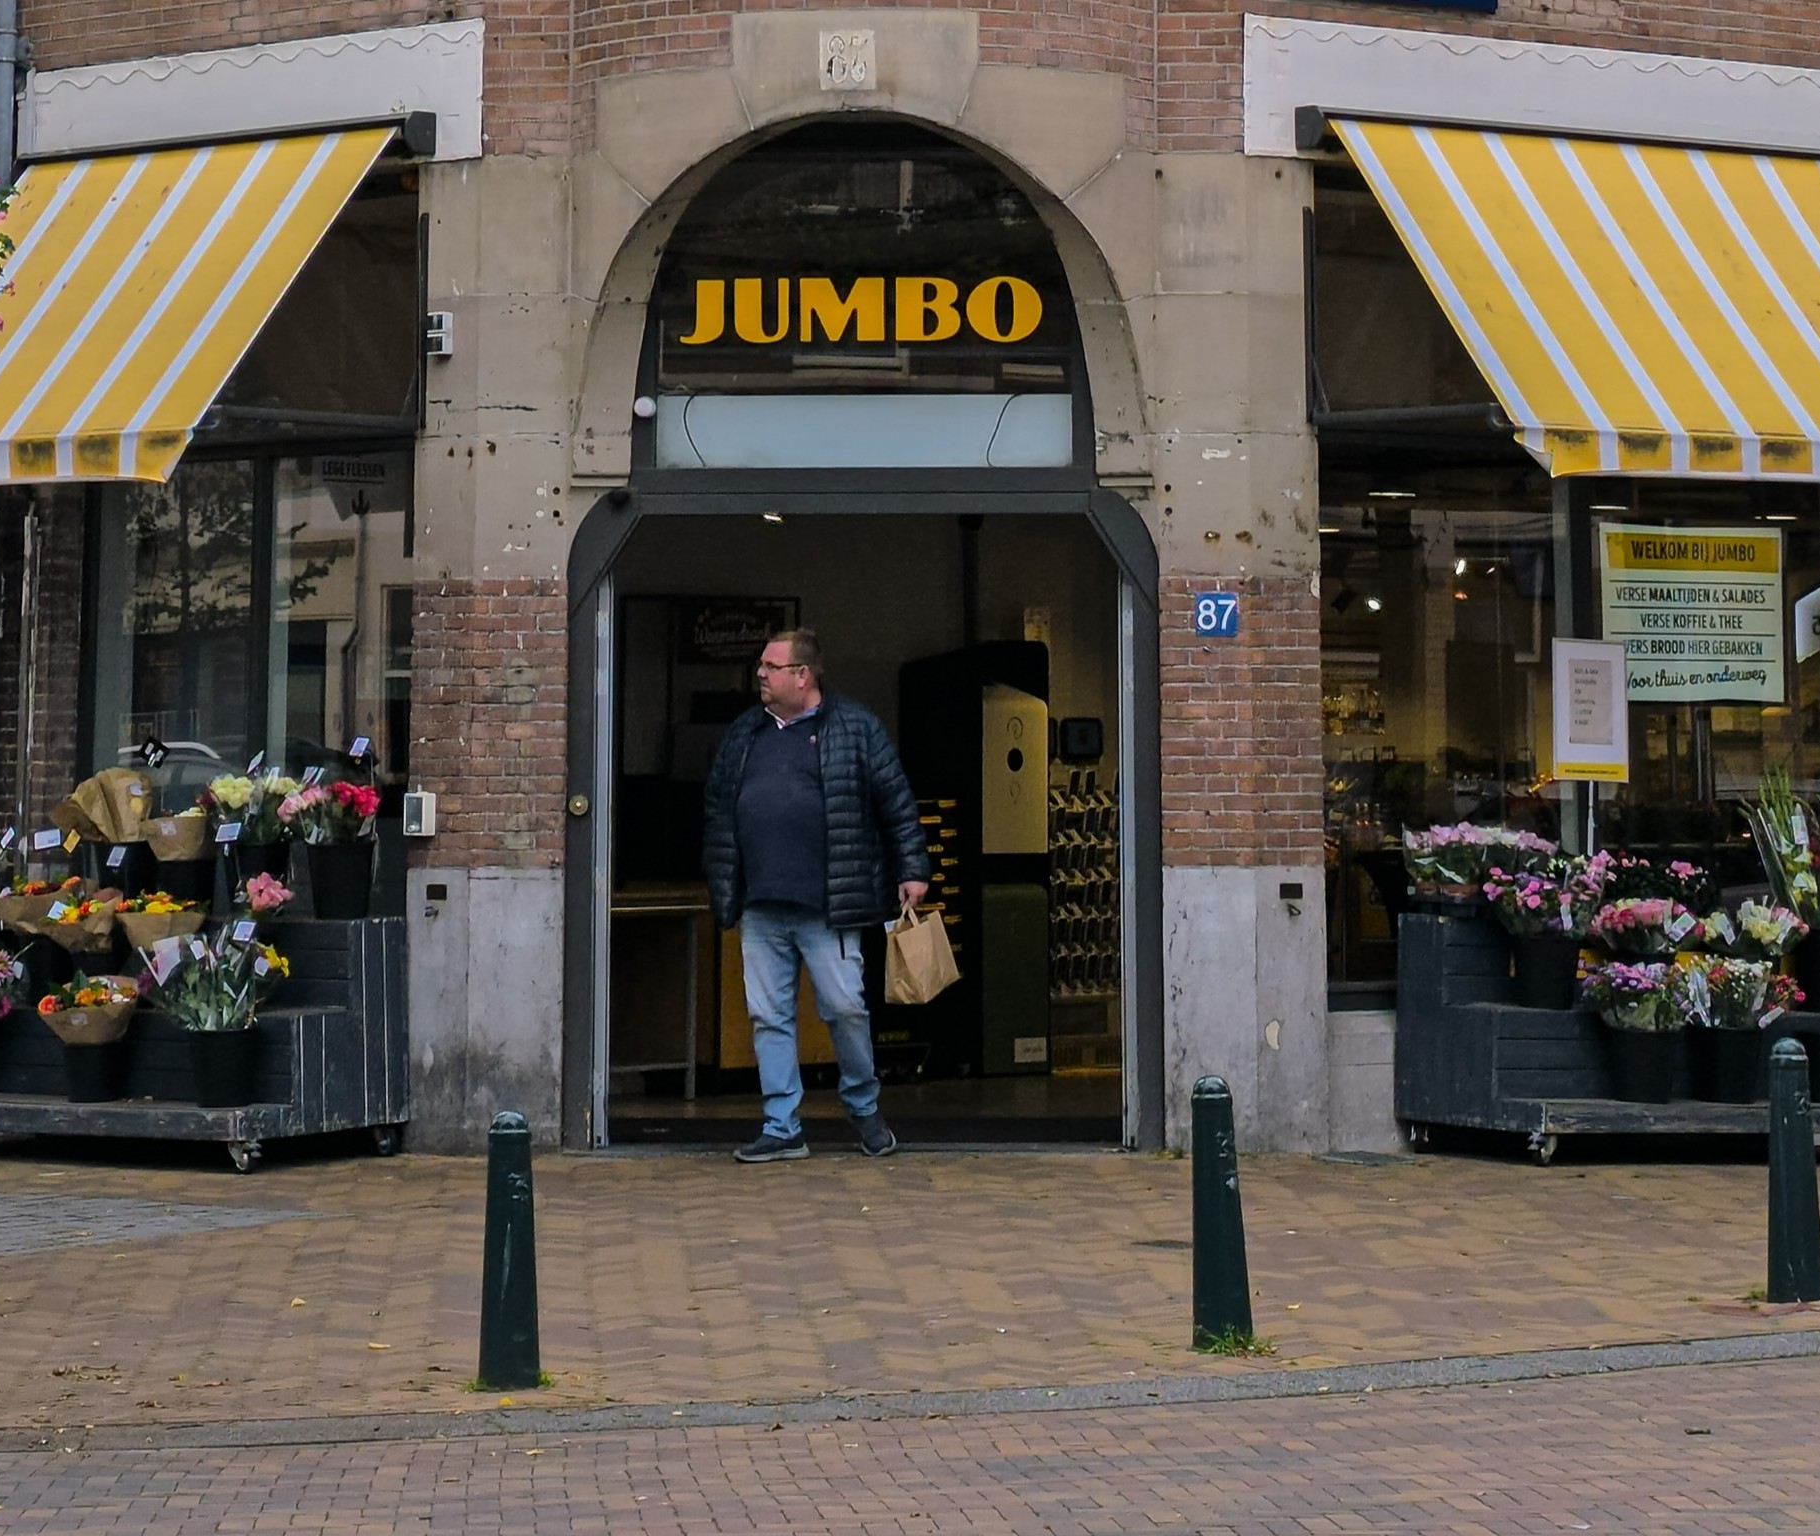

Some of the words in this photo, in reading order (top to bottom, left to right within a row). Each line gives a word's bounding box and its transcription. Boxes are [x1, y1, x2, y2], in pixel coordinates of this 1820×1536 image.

[679, 275, 1043, 345] JUMBO
[1631, 540, 1689, 560] WELKOM
[1692, 542, 1709, 563] BIJ
[1713, 543, 1756, 563] JUMBO
[1616, 586, 1647, 602] VERSE
[1649, 587, 1711, 604] MAALTIJDEN
[1712, 589, 1720, 603] &
[1721, 589, 1766, 604] SALADES
[1197, 599, 1237, 630] 87
[1640, 613, 1671, 629] VERSE
[1673, 613, 1707, 629] KOFFIE
[1709, 615, 1716, 629] &
[1718, 614, 1743, 630] THEE
[1651, 639, 1685, 654] BROOD
[1688, 640, 1711, 655] HIER
[1712, 641, 1763, 656] GEBAKKEN
[1654, 667, 1688, 687] thuis
[1689, 673, 1705, 684] en
[1706, 665, 1767, 686] onderweg
